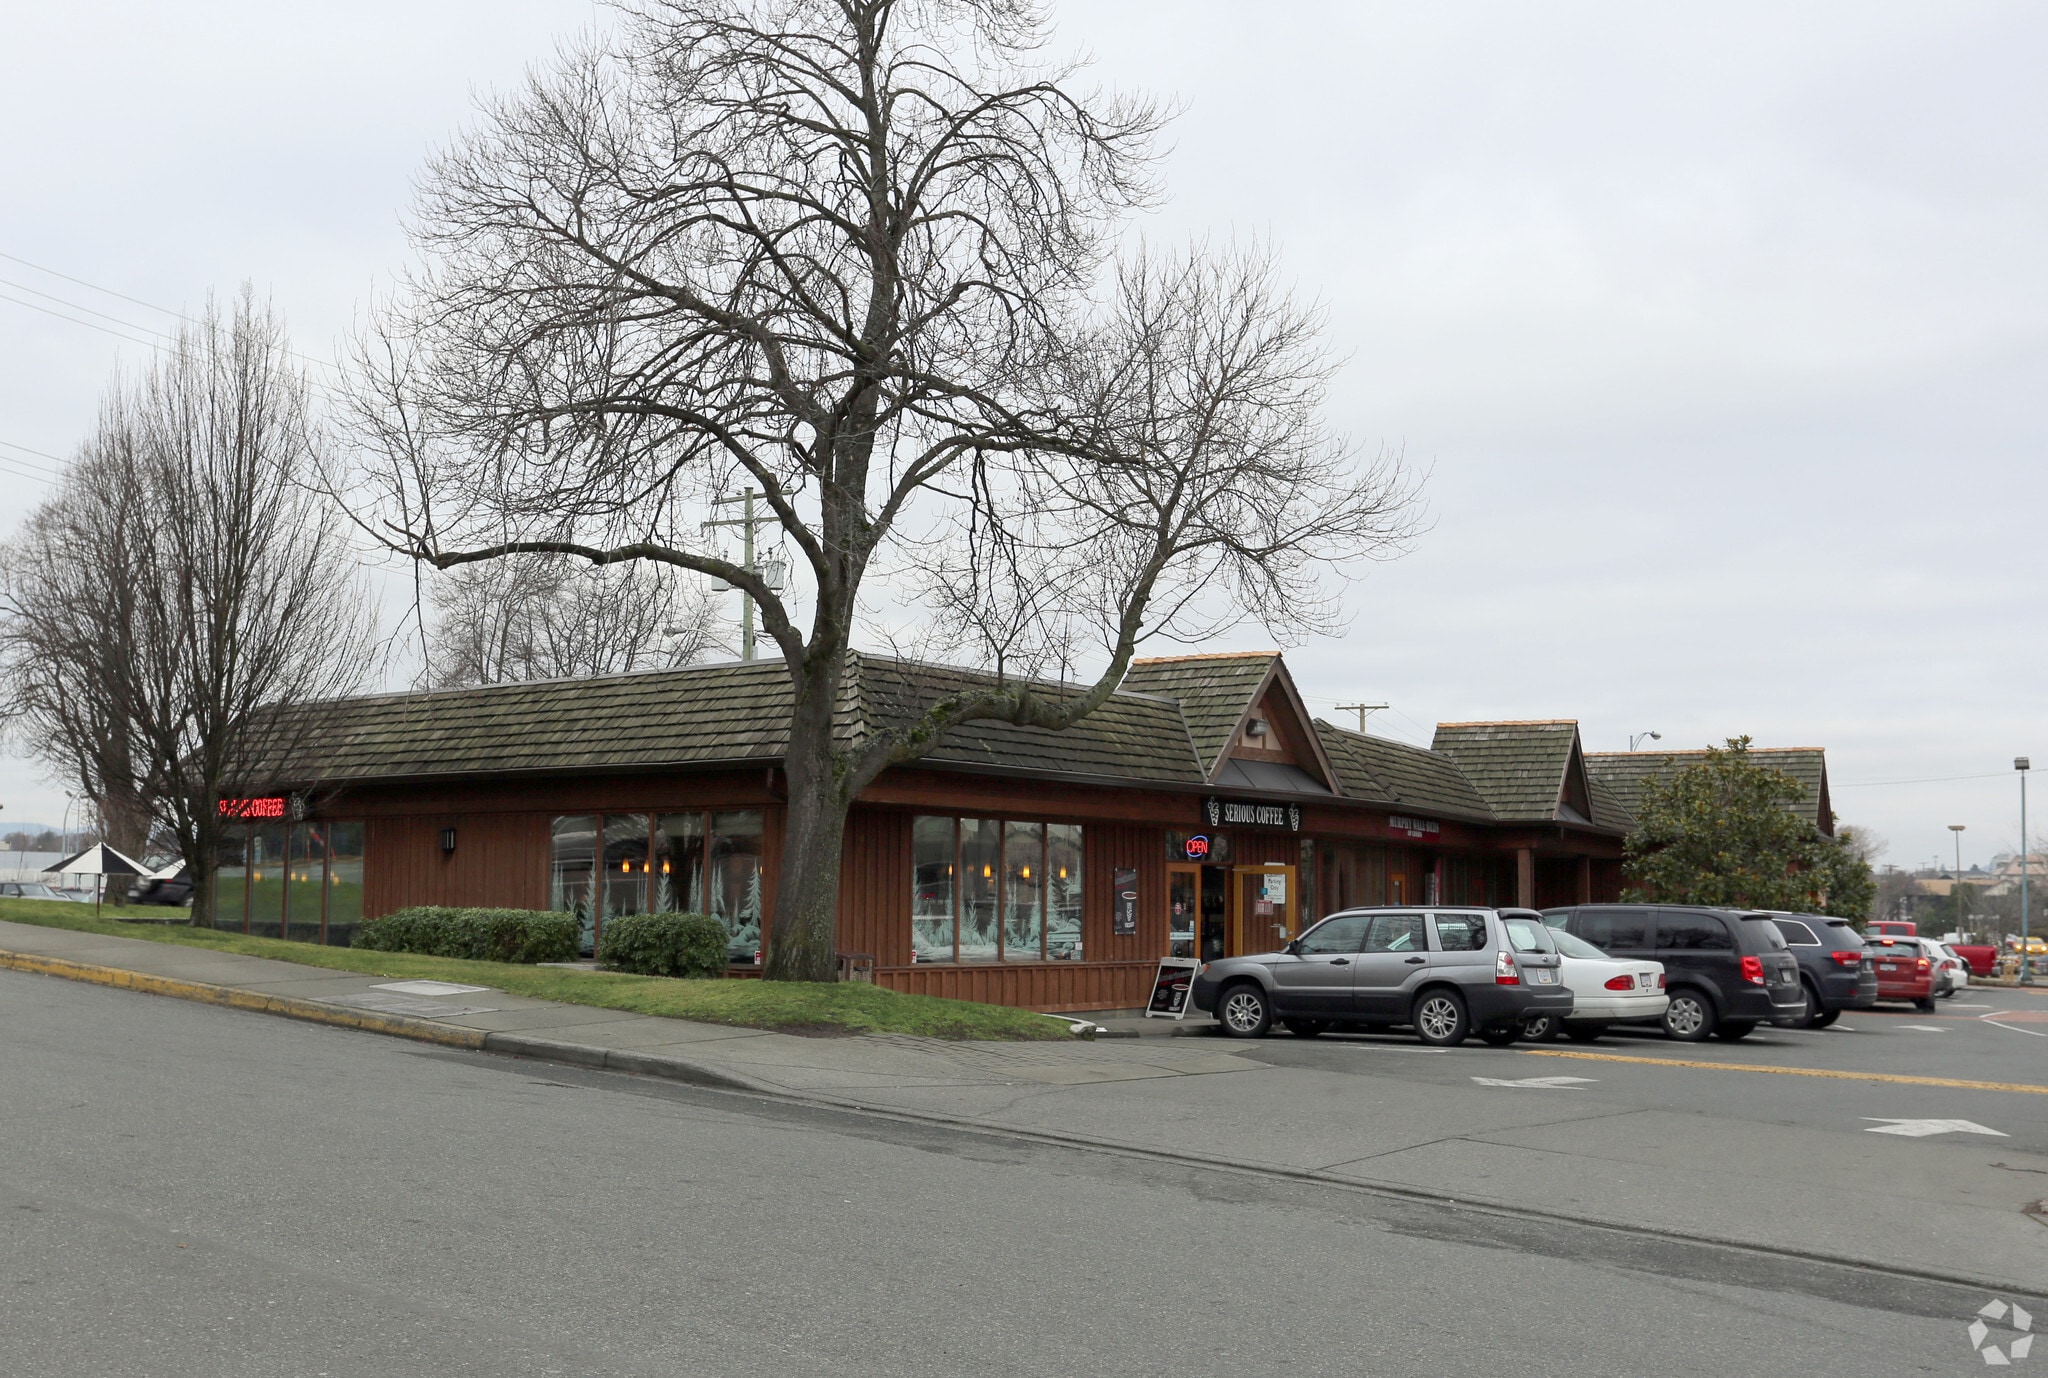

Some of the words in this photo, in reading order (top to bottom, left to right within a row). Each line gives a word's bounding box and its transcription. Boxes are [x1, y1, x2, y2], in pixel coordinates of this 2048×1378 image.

[252, 798, 284, 817] COFFEE
[1225, 803, 1255, 823] SERIOUS
[1256, 806, 1284, 825] COFFEE
[1186, 840, 1208, 853] OPEN
